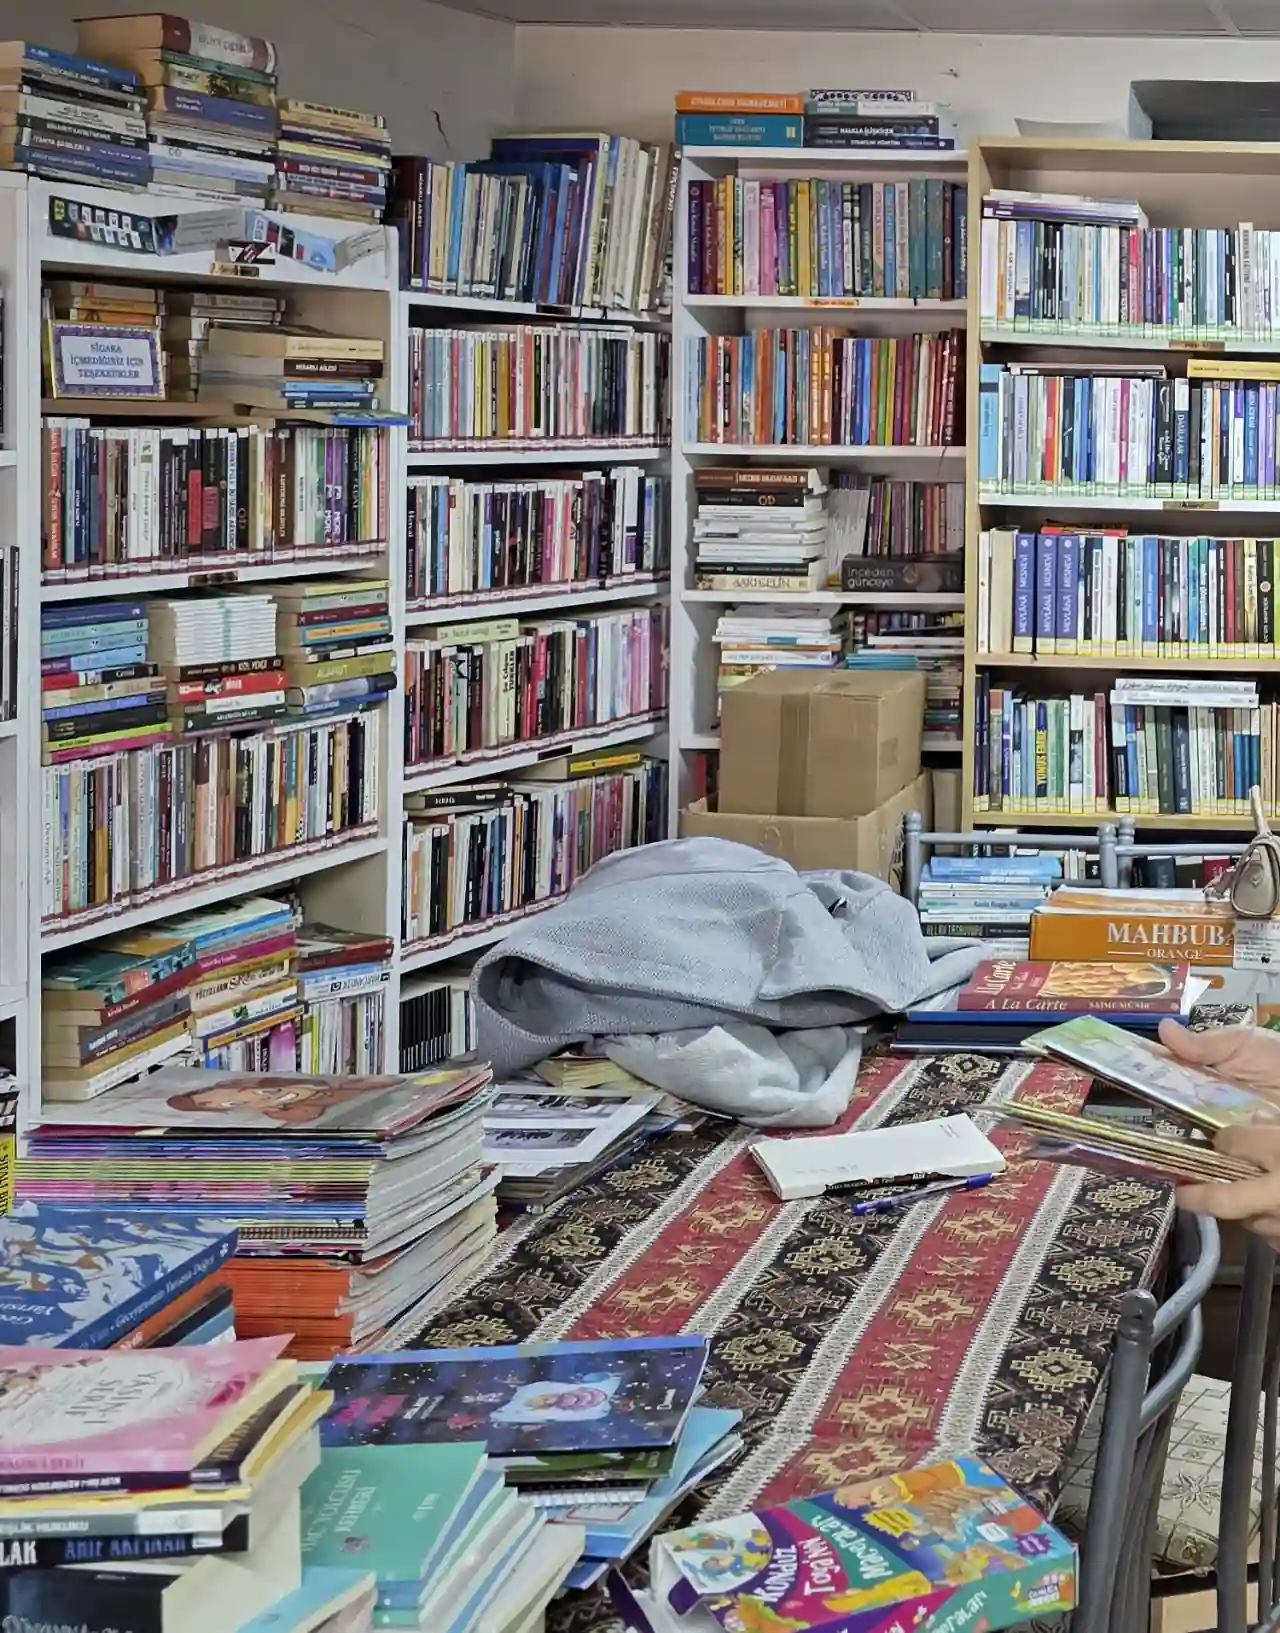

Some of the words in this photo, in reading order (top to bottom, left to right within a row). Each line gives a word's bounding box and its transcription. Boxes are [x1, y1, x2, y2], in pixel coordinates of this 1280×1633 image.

[1035, 755, 1047, 786] YUNUS
[1146, 948, 1204, 960] ORANGE
[984, 1001, 996, 1010] A
[1002, 1001, 1021, 1010] La
[1026, 1000, 1069, 1011] Carte
